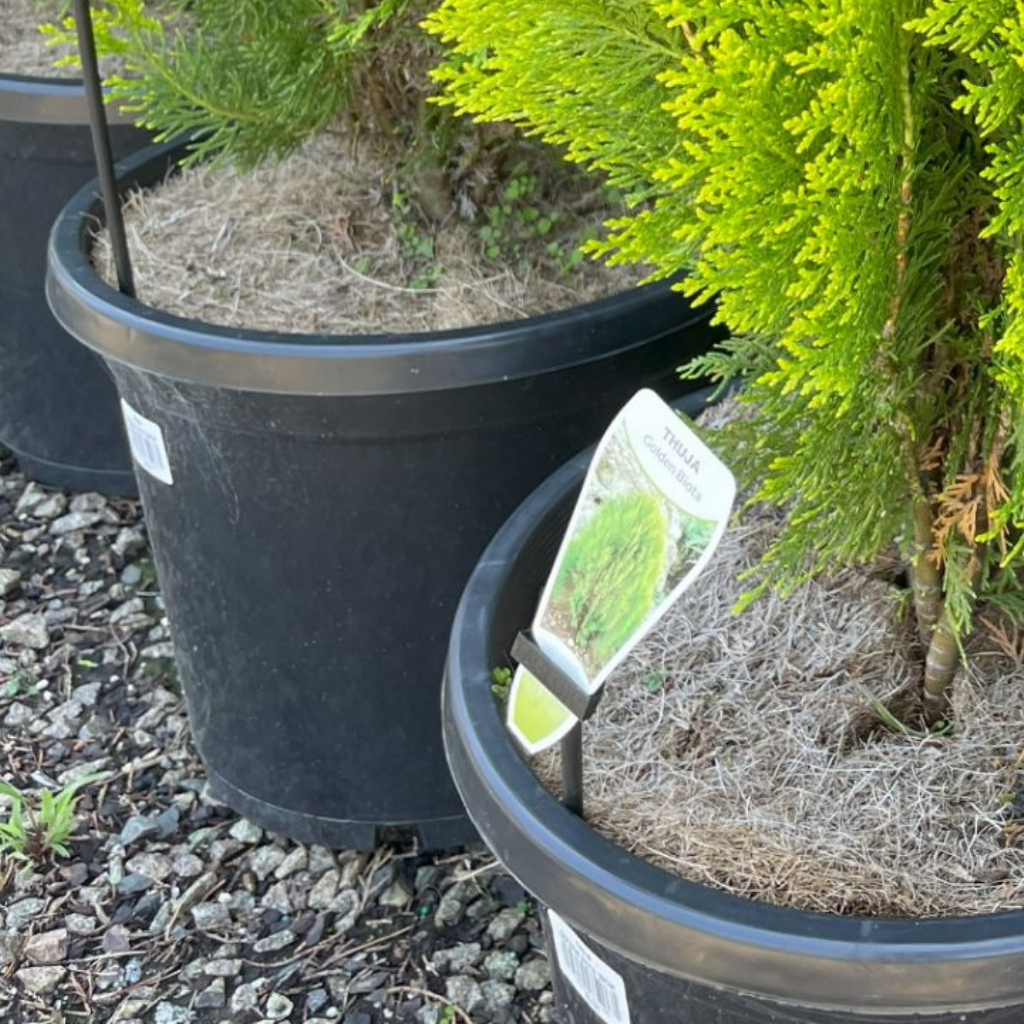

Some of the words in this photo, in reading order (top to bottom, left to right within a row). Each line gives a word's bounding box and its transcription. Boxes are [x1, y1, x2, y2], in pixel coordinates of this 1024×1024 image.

[643, 434, 677, 475] Golden
[675, 469, 702, 502] Biota
[663, 426, 700, 475] THUJA
